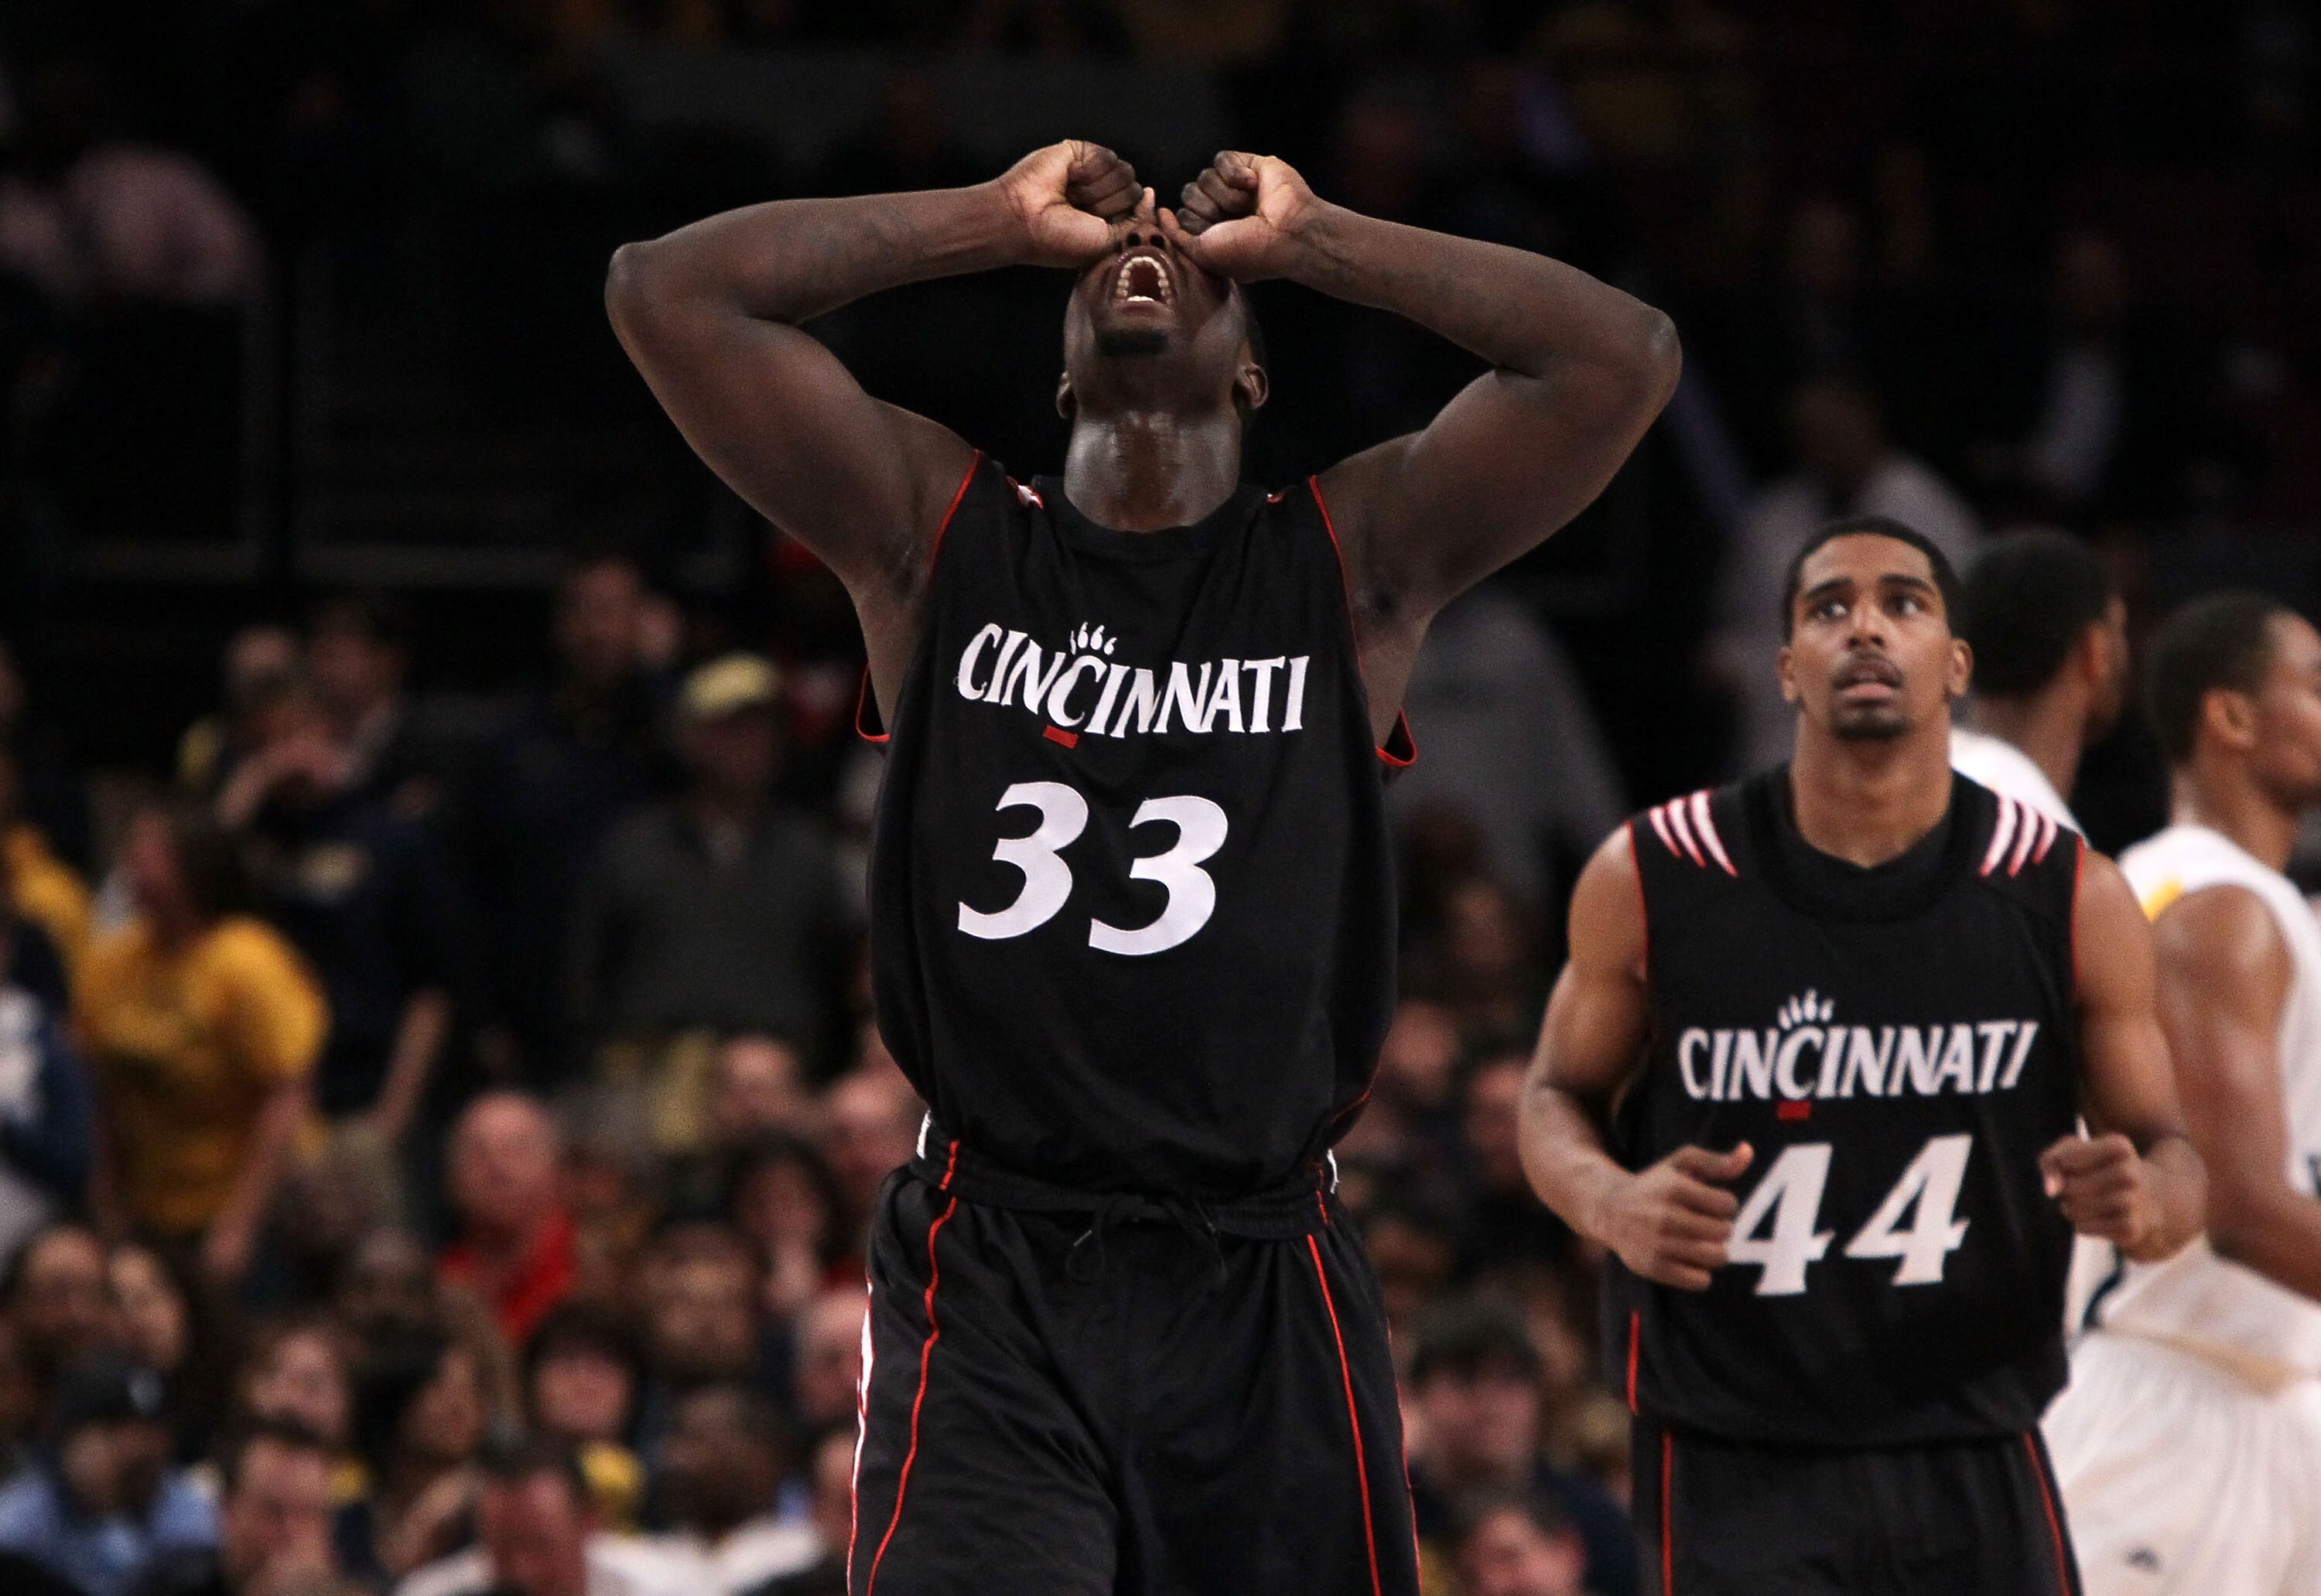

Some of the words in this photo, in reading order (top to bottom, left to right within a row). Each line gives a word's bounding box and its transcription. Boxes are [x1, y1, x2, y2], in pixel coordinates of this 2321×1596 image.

[956, 623, 1310, 739] CINCINNATI
[957, 781, 1229, 956] 33
[1678, 1020, 2038, 1100] CINCINNATI
[1723, 1133, 1972, 1295] 44
